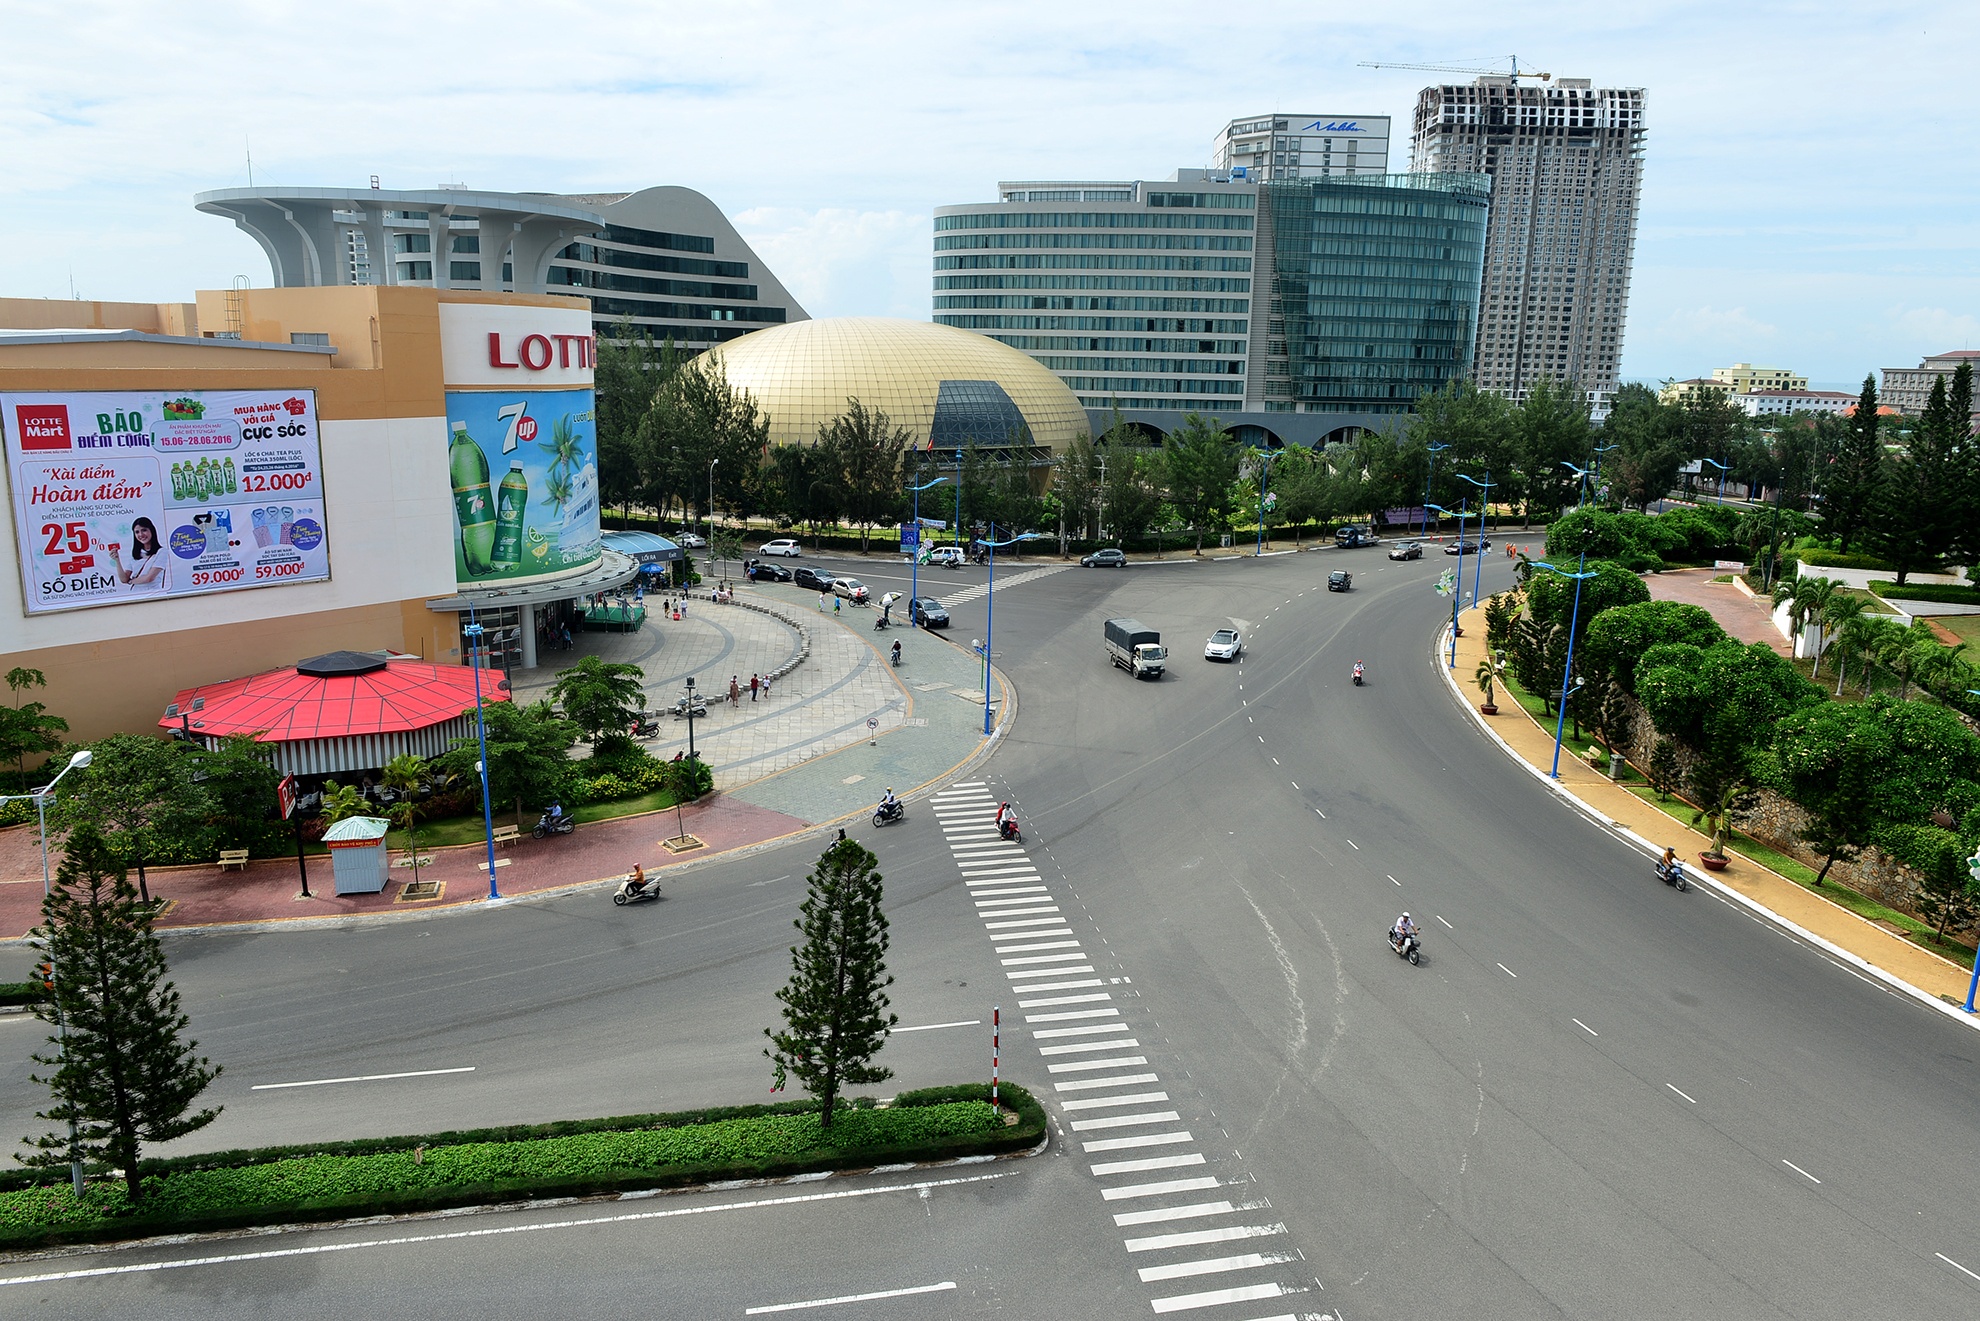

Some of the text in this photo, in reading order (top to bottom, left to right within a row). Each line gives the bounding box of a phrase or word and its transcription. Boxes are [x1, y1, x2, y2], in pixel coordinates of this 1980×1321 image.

[1302, 121, 1366, 132] Malibu
[258, 404, 281, 413] HÀNG
[96, 408, 143, 434] BÃO
[243, 413, 276, 424] VỚI GIÁ
[27, 426, 64, 437] Mart
[243, 420, 306, 442] CỰC SỐC
[78, 432, 113, 448] ĐIỂM
[161, 435, 232, 446] 15.06~28.06.2016
[80, 464, 115, 479] điểm
[242, 472, 312, 492] 12.000đ
[31, 484, 88, 504] Hoàn
[192, 568, 244, 585] 39.000đ
[256, 562, 304, 578] 59.000đ
[43, 572, 115, 594] SỐ ĐIỂM
